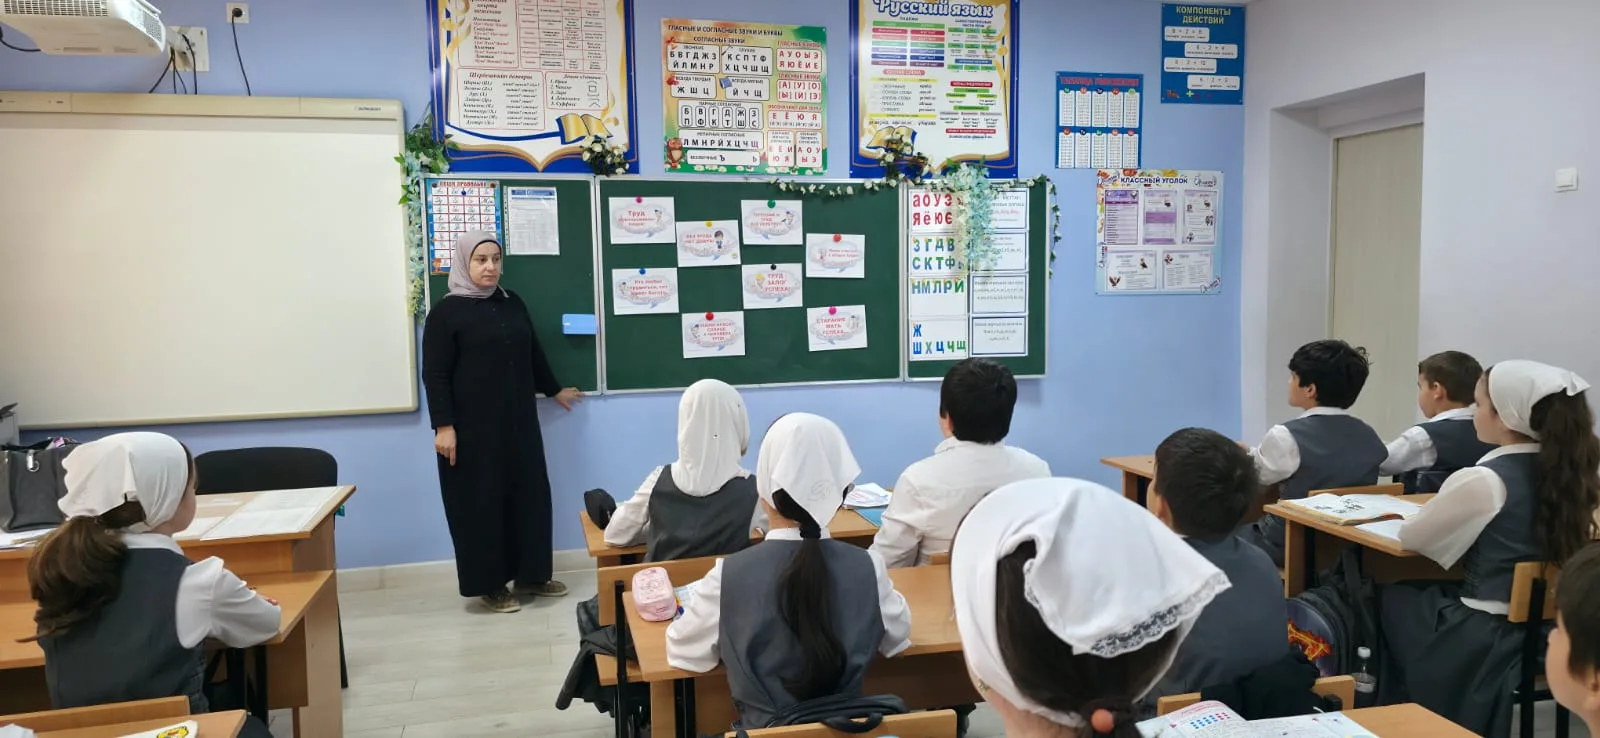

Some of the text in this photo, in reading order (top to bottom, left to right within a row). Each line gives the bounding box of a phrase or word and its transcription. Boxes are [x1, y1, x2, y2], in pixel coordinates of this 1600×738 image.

[872, 0, 994, 18] Русский язык
[1176, 6, 1231, 16] КОМПОНЕНТЫ
[702, 26, 737, 34] СОГЛАСНЫЕ
[693, 52, 699, 60] Д
[701, 52, 709, 60] Ж
[673, 60, 679, 69] Й
[733, 64, 740, 72] Ц
[742, 64, 748, 72] Ч
[761, 65, 769, 74] Щ
[677, 86, 685, 94] Ж
[703, 87, 709, 95] Ц
[732, 88, 738, 97] Й
[754, 89, 762, 98] Щ
[684, 107, 690, 115] Б
[724, 109, 731, 117] Д
[772, 112, 777, 120] Е
[691, 138, 699, 146] М
[718, 138, 724, 147] Й
[734, 140, 741, 148] Ц
[751, 140, 759, 148] Щ
[719, 154, 726, 162] Ъ
[1121, 176, 1160, 184] КЛАССНЫЙ
[913, 323, 922, 338] Ж
[913, 340, 966, 355] Ш Х Ц Ч Щ
